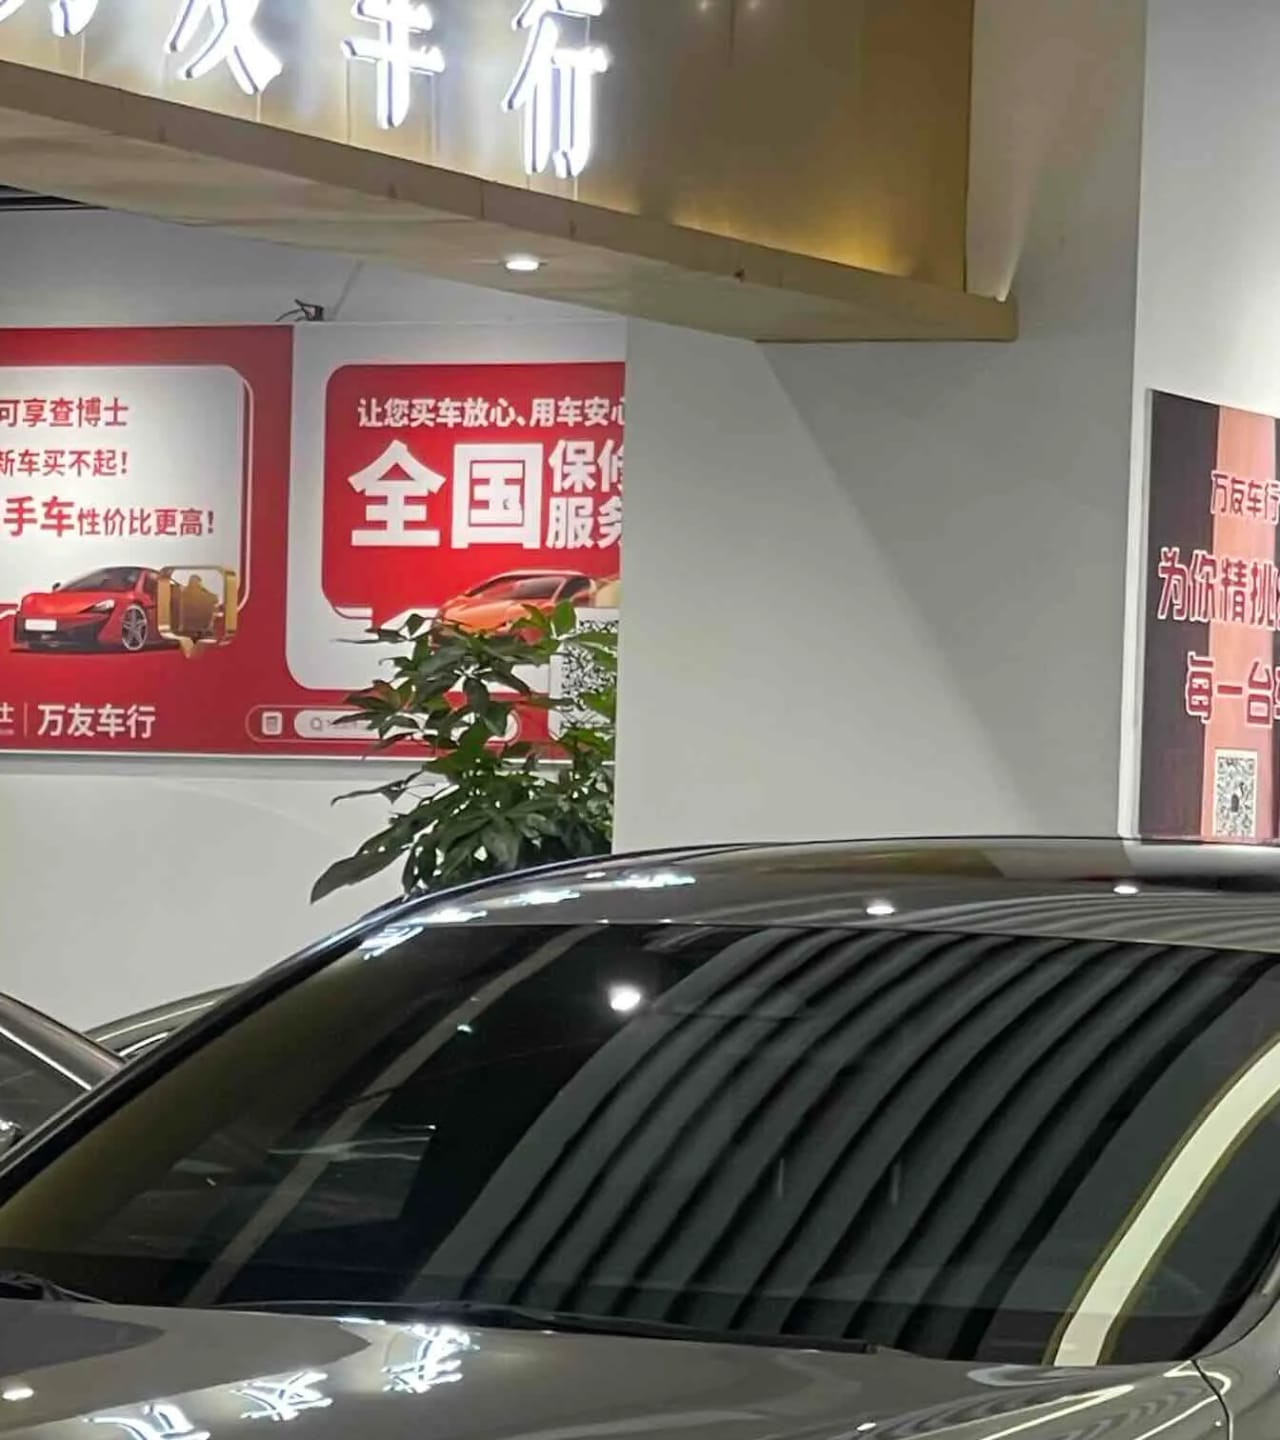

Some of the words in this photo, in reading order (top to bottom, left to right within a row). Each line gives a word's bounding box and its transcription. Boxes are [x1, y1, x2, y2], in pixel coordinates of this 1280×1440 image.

[347, 439, 543, 549] 全国
[1210, 470, 1280, 524] 万友车行
[37, 703, 156, 738] 万友车行
